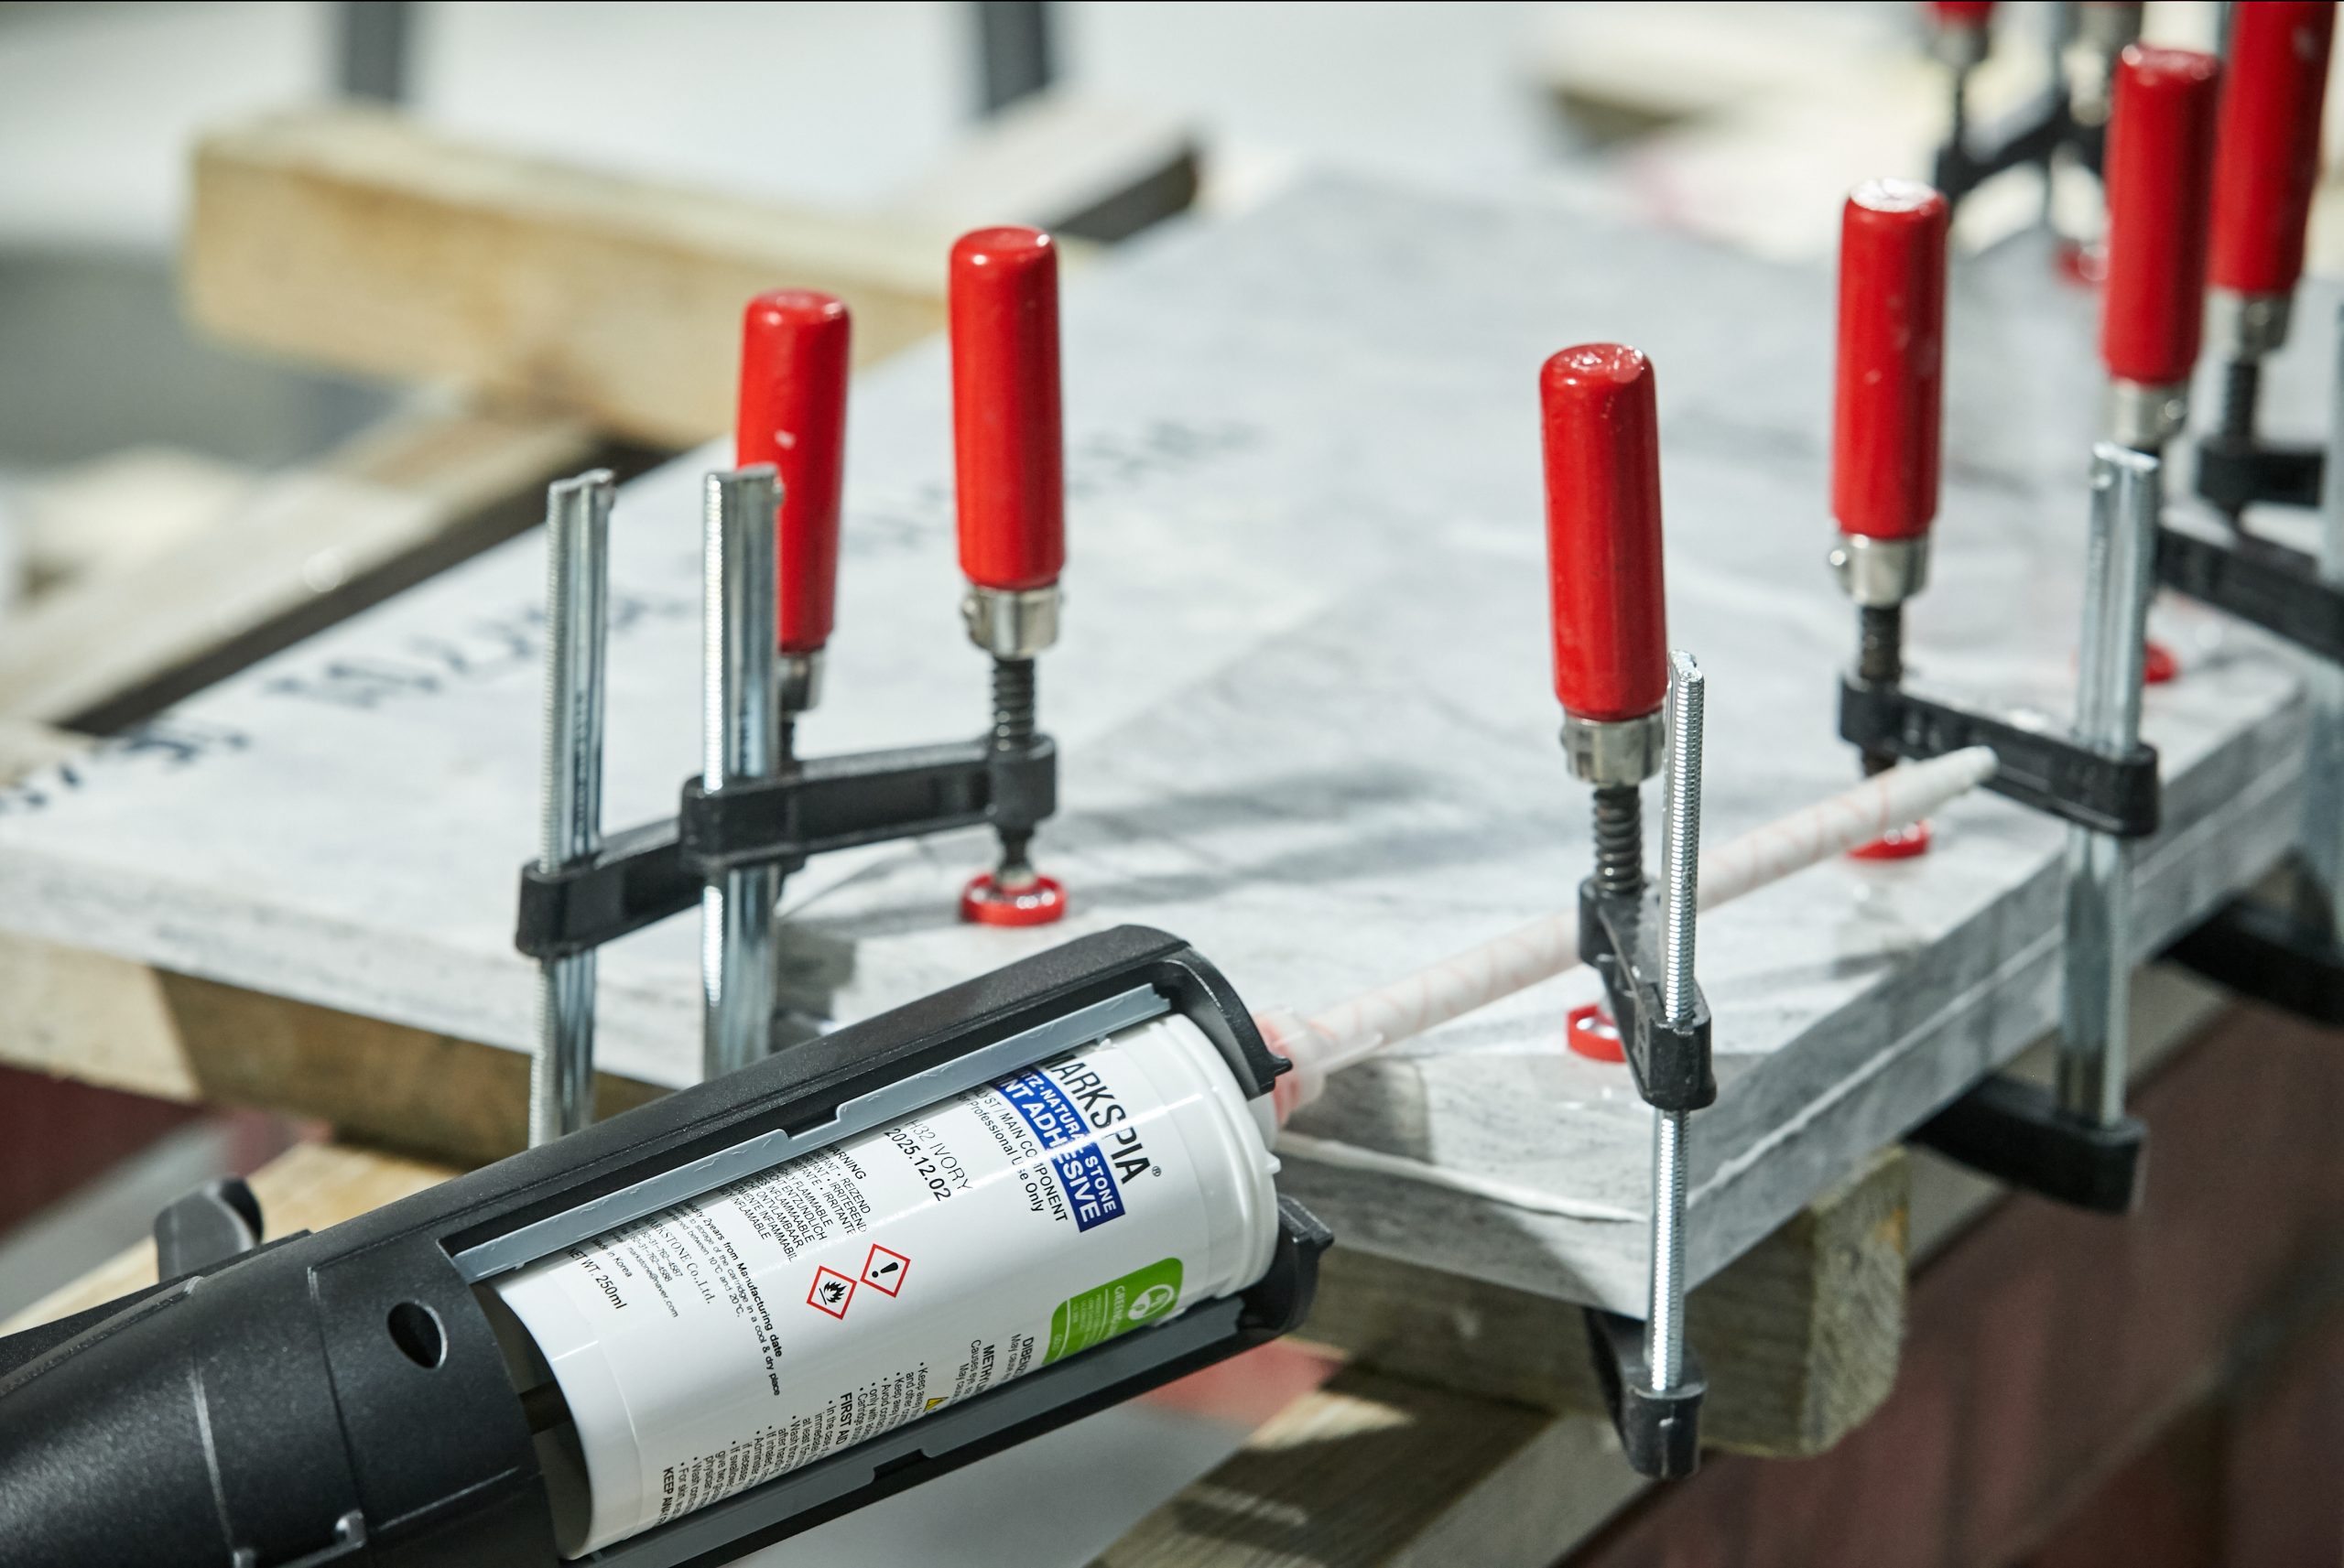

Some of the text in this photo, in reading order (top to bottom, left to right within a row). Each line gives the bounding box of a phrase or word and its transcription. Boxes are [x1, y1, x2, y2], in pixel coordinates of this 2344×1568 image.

[998, 1111, 1026, 1140] MAIN
[882, 1127, 952, 1202] 2025.12.02
[903, 1119, 973, 1194] H32 IVORY
[965, 1100, 1018, 1155] Professional
[1022, 1182, 1047, 1215] Only
[1021, 1098, 1101, 1223] ADHESIVE
[839, 1177, 872, 1215] REIZEND
[1083, 1155, 1117, 1214] STONE
[765, 1184, 815, 1243] INFLAMMAABLE
[780, 1184, 827, 1240] ENTZUNDLICH
[792, 1180, 833, 1227] FLAMMABLE
[821, 1191, 857, 1237] IRRITANTE
[828, 1182, 868, 1233] IRRITEREND
[728, 1196, 771, 1239] INFLAMABLE
[754, 1190, 804, 1248] ONTVLAMBAAR
[692, 1223, 716, 1246] storage
[629, 1235, 673, 1282] 82-31-762-4588
[639, 1231, 683, 1278] 82-31-762-4587
[686, 1229, 711, 1256] between
[719, 1274, 732, 1289] and
[711, 1245, 722, 1255] of
[717, 1254, 730, 1267] the
[561, 1248, 588, 1260] NET
[594, 1274, 628, 1310] 250ml
[612, 1256, 635, 1278] Korea
[624, 1246, 679, 1319] markstone@naver.com
[700, 1217, 727, 1241] 2years
[722, 1240, 740, 1260] from
[735, 1261, 774, 1332] Manufacturing
[768, 1333, 784, 1358] date
[725, 1267, 750, 1303] cartridge
[745, 1303, 755, 1314] in
[750, 1315, 758, 1324] a
[754, 1324, 766, 1344] cool
[1008, 1333, 1020, 1353] May
[761, 1344, 771, 1354] &
[969, 1338, 981, 1373] Causes
[763, 1354, 776, 1372] dry
[955, 1362, 968, 1382] May
[768, 1372, 780, 1397] place
[892, 1377, 903, 1400] Keep
[905, 1370, 915, 1390] and
[916, 1367, 927, 1391] Keep
[867, 1387, 877, 1408] only
[880, 1382, 890, 1407] Avoid
[903, 1388, 914, 1409] other
[911, 1390, 924, 1410] away
[826, 1405, 836, 1416] In
[834, 1391, 852, 1445] FIRST AID
[853, 1391, 866, 1427] Cartridge
[867, 1405, 877, 1423] with
[888, 1398, 900, 1417] away
[789, 1420, 799, 1446] Wash
[802, 1416, 811, 1427] at
[826, 1415, 835, 1430] the
[765, 1430, 776, 1440] If
[777, 1426, 787, 1448] after
[801, 1425, 811, 1445] least
[715, 1449, 726, 1469] give
[730, 1444, 740, 1454] If
[662, 1465, 674, 1497] KEEP
[678, 1466, 689, 1484] For
[690, 1461, 701, 1487] Wash
[715, 1467, 726, 1483] two
